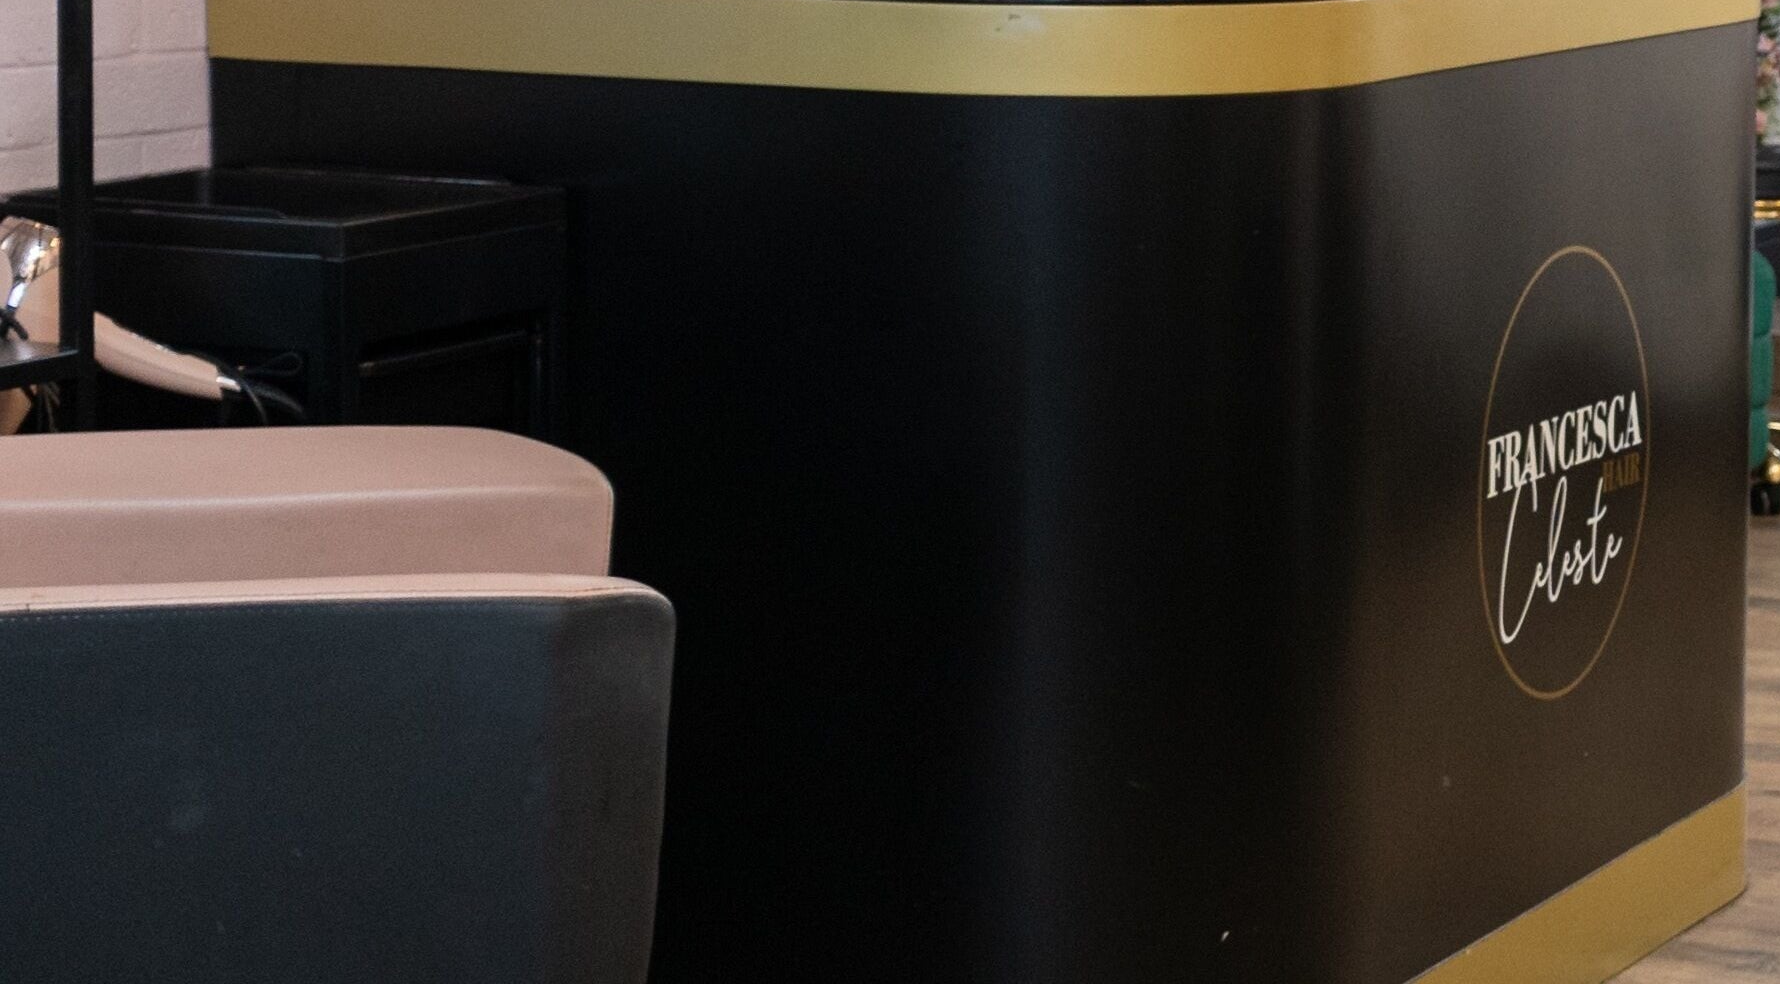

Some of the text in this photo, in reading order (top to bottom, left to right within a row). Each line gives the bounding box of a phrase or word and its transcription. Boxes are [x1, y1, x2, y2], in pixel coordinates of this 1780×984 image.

[1487, 391, 1643, 499] FRANCESCA
[1603, 452, 1642, 494] HAIR
[1499, 466, 1623, 644] Celeste
